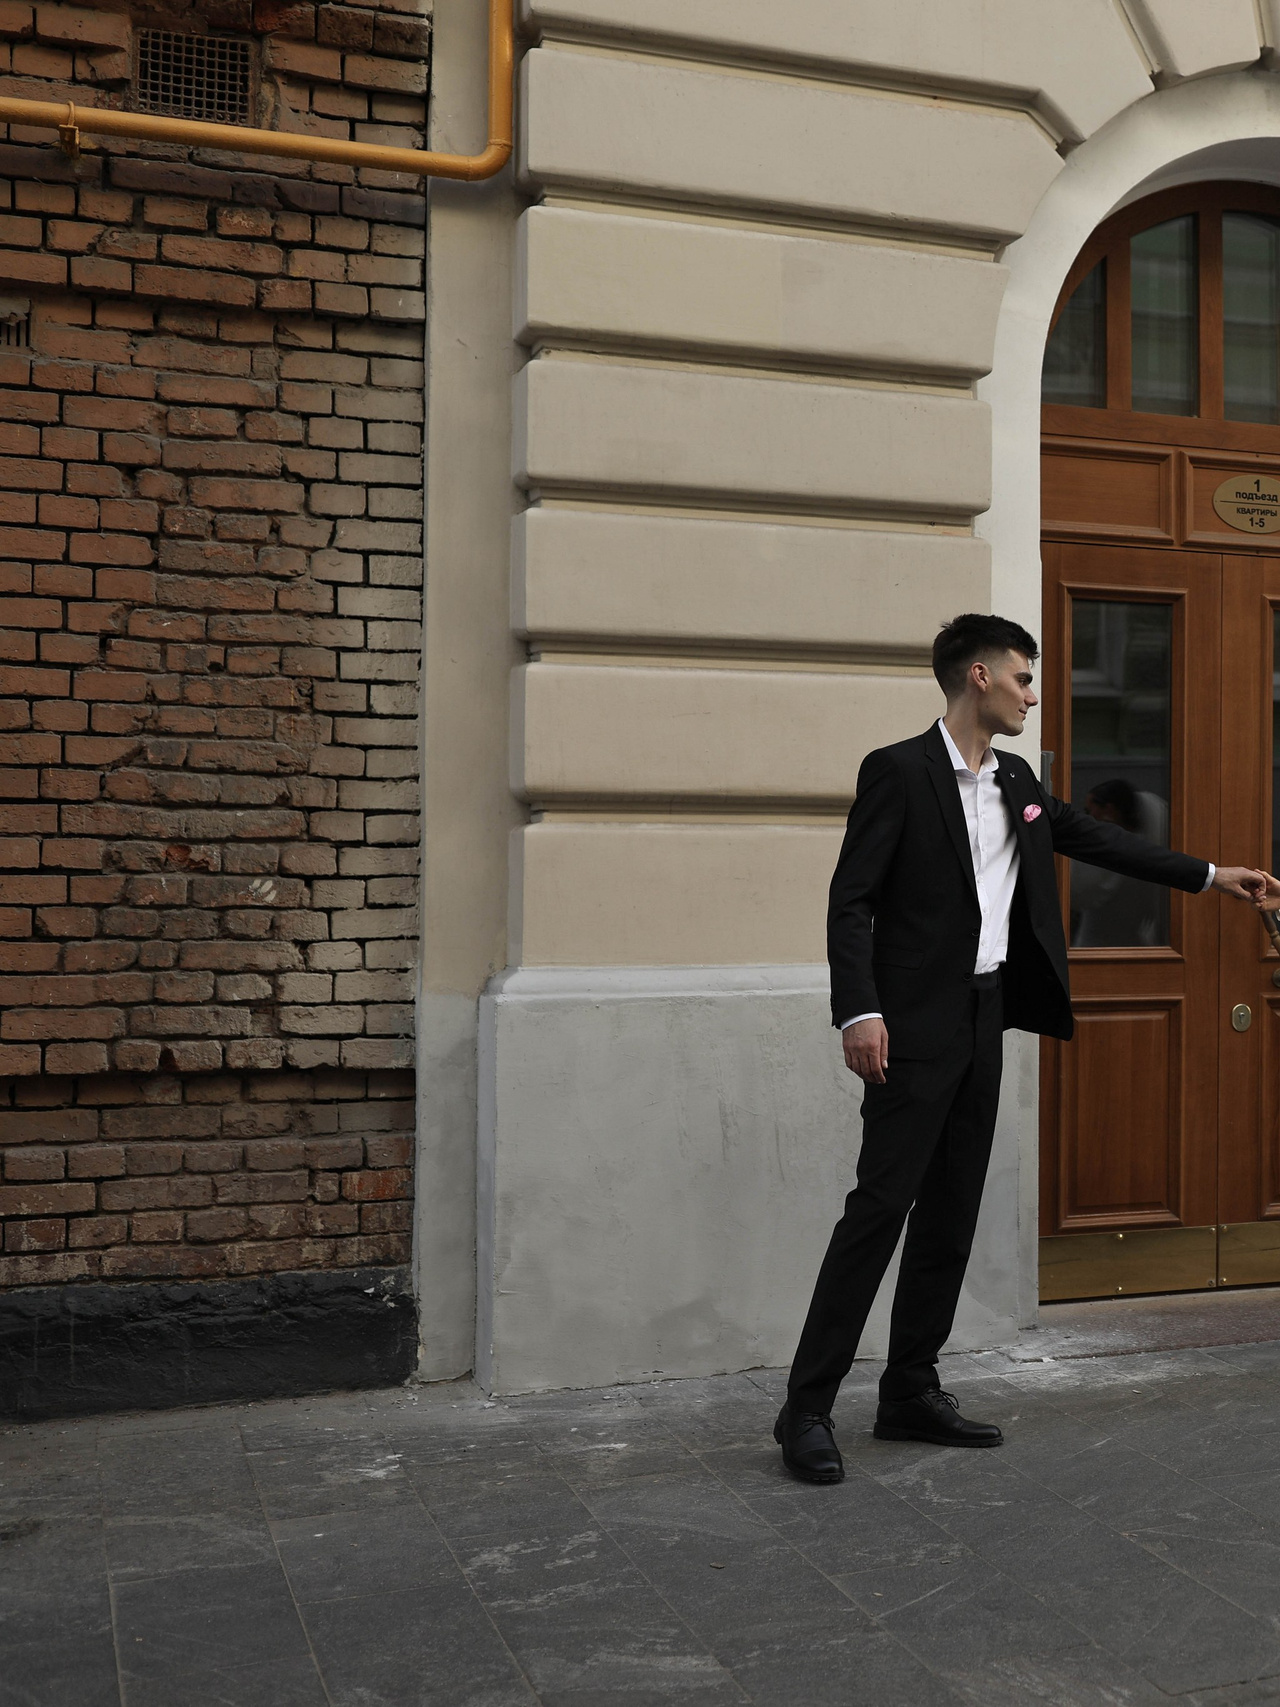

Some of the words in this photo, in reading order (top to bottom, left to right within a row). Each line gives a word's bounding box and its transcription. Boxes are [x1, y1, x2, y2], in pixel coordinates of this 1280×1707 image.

[1253, 479, 1261, 492] 1
[1235, 491, 1279, 503] подъезд
[1236, 507, 1278, 517] КВАРТИРЫ
[1249, 517, 1265, 528] 1-5
